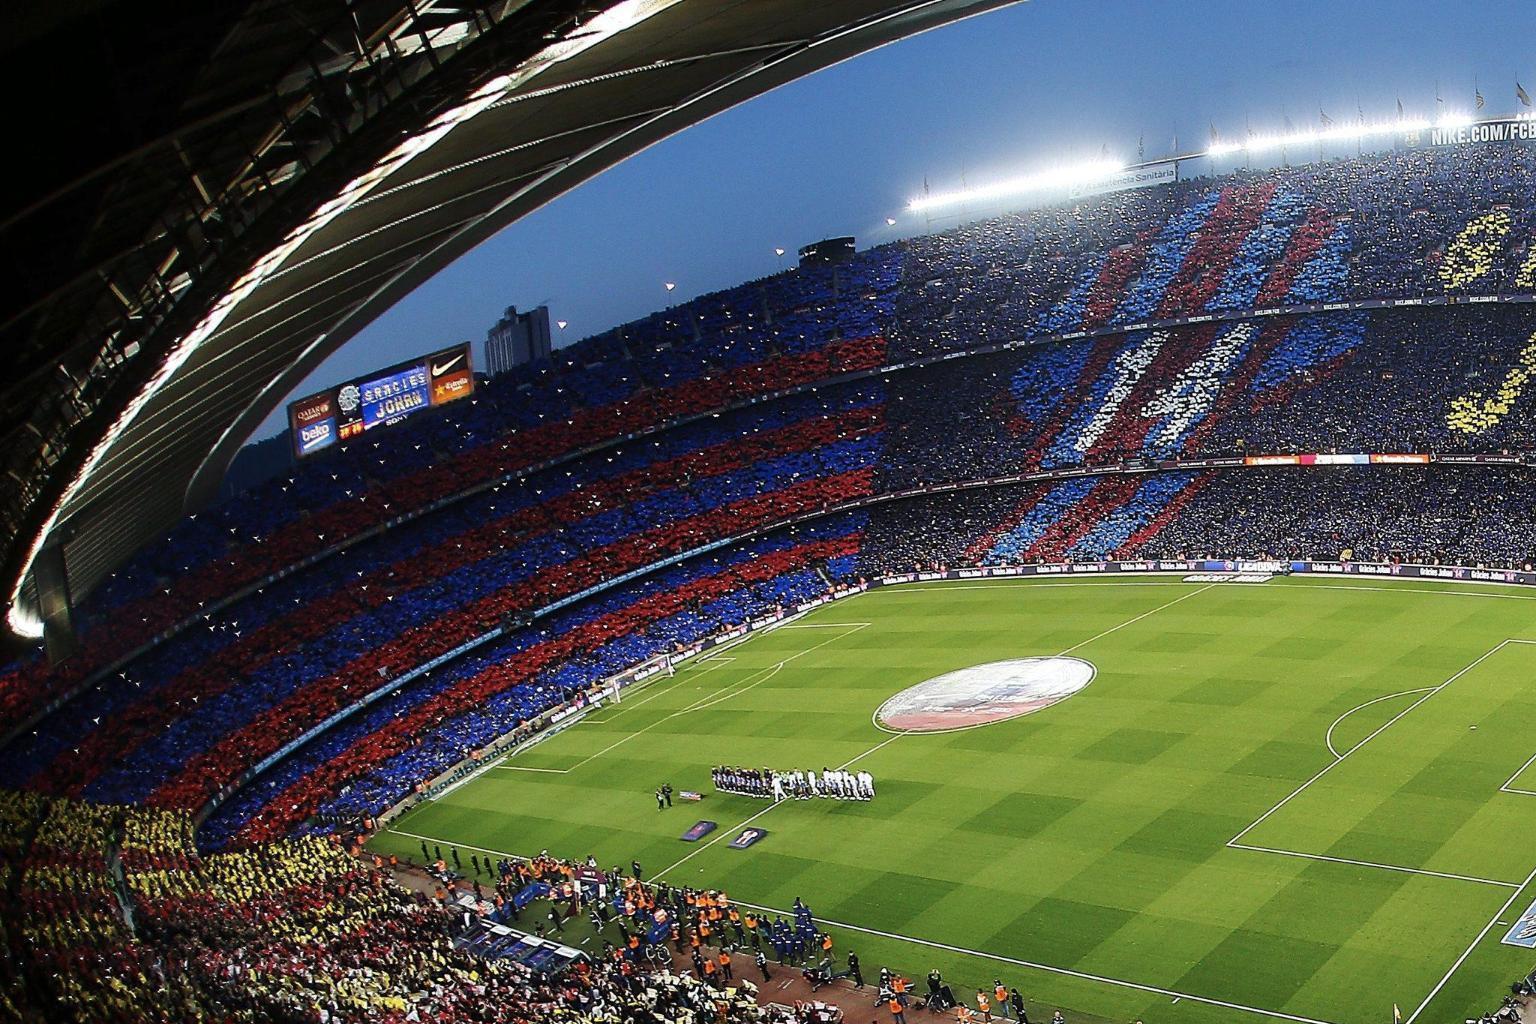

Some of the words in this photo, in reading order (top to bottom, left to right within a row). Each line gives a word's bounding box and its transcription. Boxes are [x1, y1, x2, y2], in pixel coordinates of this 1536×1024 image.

[1135, 169, 1174, 182] Sanitària
[1073, 322, 1253, 452] 14
[376, 390, 423, 418] JOHAN
[386, 414, 408, 426] SONY
[302, 423, 330, 441] beko
